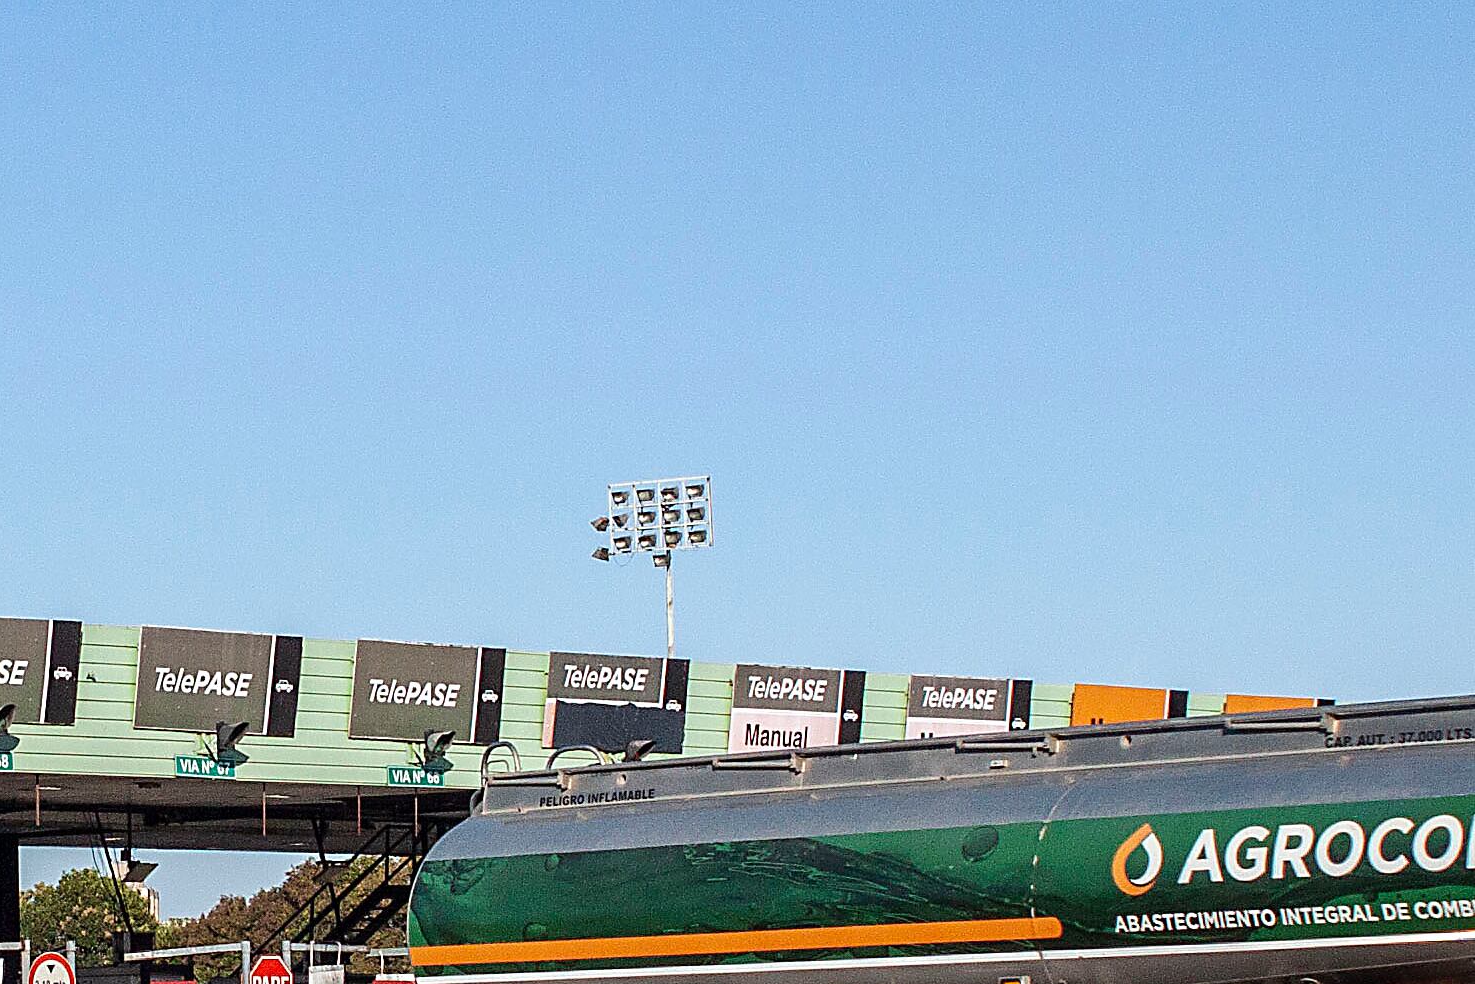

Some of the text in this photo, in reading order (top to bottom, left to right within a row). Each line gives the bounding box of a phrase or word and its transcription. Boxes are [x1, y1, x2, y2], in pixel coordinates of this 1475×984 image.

[155, 666, 253, 698] TelePASE
[563, 664, 650, 692] TelePASE
[748, 676, 827, 701] TelePASE
[368, 678, 461, 708] TelePASE
[922, 685, 998, 711] TelePASE
[745, 723, 808, 748] Manual
[1398, 730, 1442, 744] 37.000
[180, 759, 199, 774] VIA
[217, 761, 230, 775] 67
[392, 769, 411, 783] VIA
[539, 788, 655, 807] PELIGRO INFLAMABLE
[1114, 899, 1475, 933] ABASTECIMIENTO INTEGRAL DE COMB
